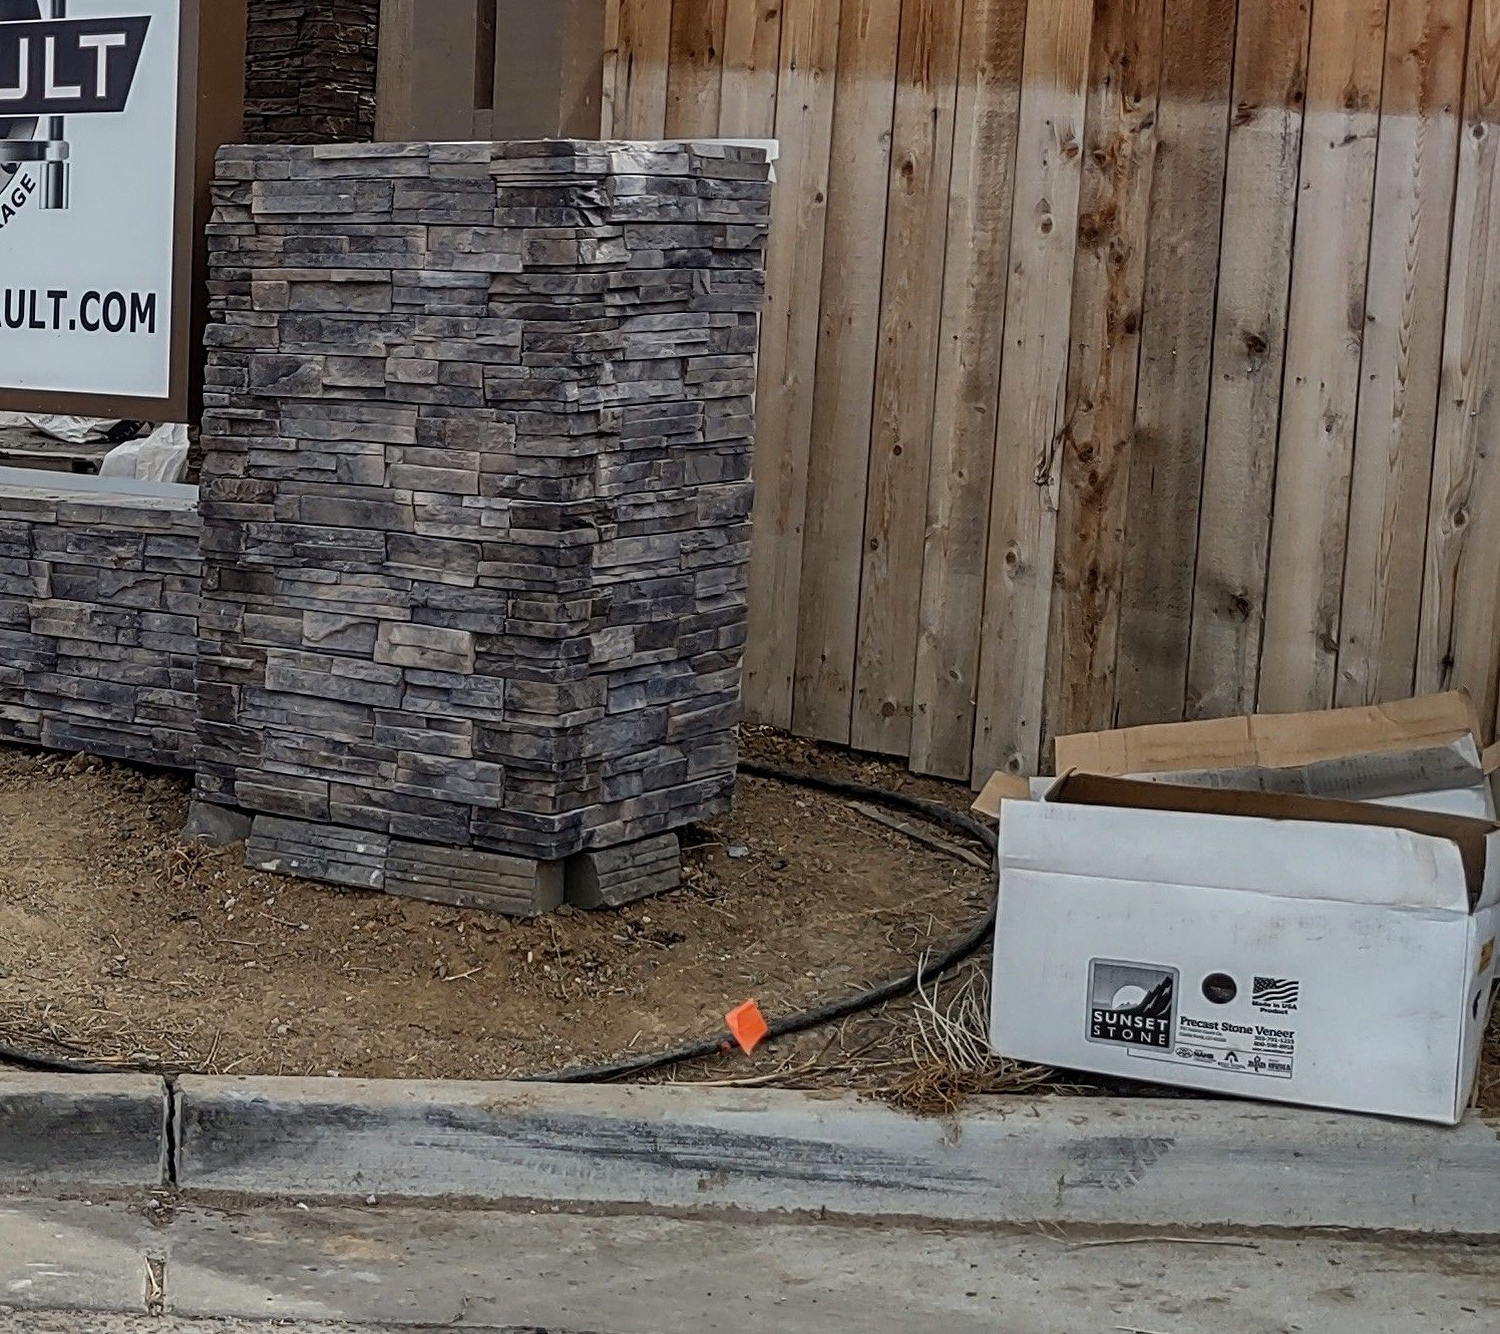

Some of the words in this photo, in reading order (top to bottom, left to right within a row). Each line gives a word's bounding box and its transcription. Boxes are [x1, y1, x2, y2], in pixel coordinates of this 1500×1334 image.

[1252, 1000, 1271, 1008] Made
[1260, 1007, 1288, 1015] Product
[1093, 1011, 1168, 1031] SUNSET
[1179, 1015, 1219, 1030] Precast
[1221, 1021, 1253, 1035] Stone
[1255, 1026, 1295, 1038] Veneer
[1093, 1025, 1166, 1045] STONE
